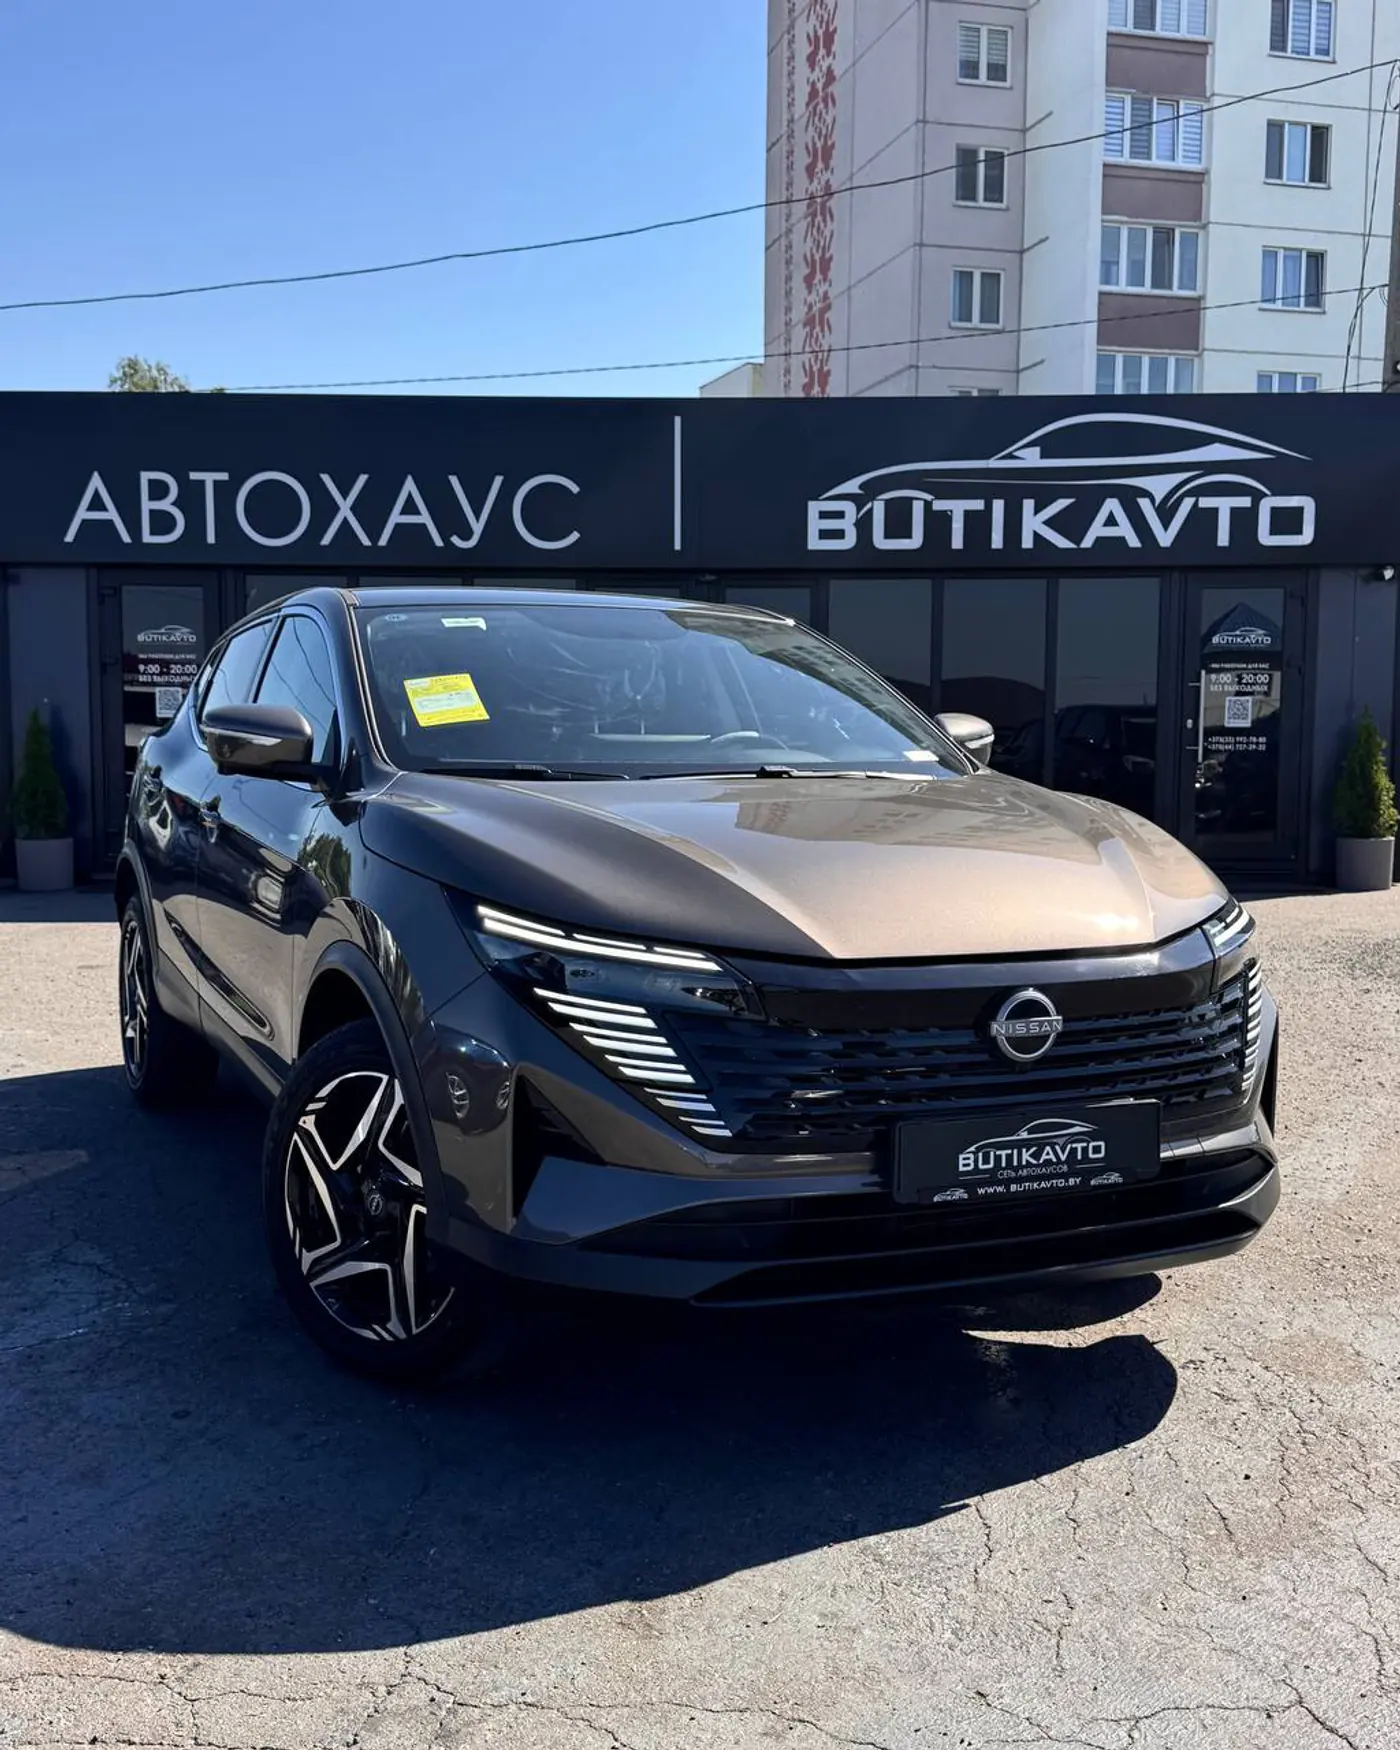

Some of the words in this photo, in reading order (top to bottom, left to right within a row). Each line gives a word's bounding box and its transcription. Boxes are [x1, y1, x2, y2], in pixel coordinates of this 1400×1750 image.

[63, 470, 581, 549] АВТОХАУС
[807, 495, 1316, 550] BUTIKAVTO
[1212, 636, 1272, 644] BUTIKAVTO
[138, 664, 160, 674] 9:00
[169, 664, 198, 674] 20:00
[1210, 673, 1232, 684] 9:00
[1241, 673, 1269, 684] 20:00
[993, 1021, 1061, 1034] NISSAN
[958, 1141, 1106, 1172] BUTIKAVTO
[1017, 1164, 1069, 1178] АВТОХАУСОВ
[977, 1184, 1006, 1195] WWW.
[1010, 1177, 1082, 1192] BUTIKAVTO.BY
